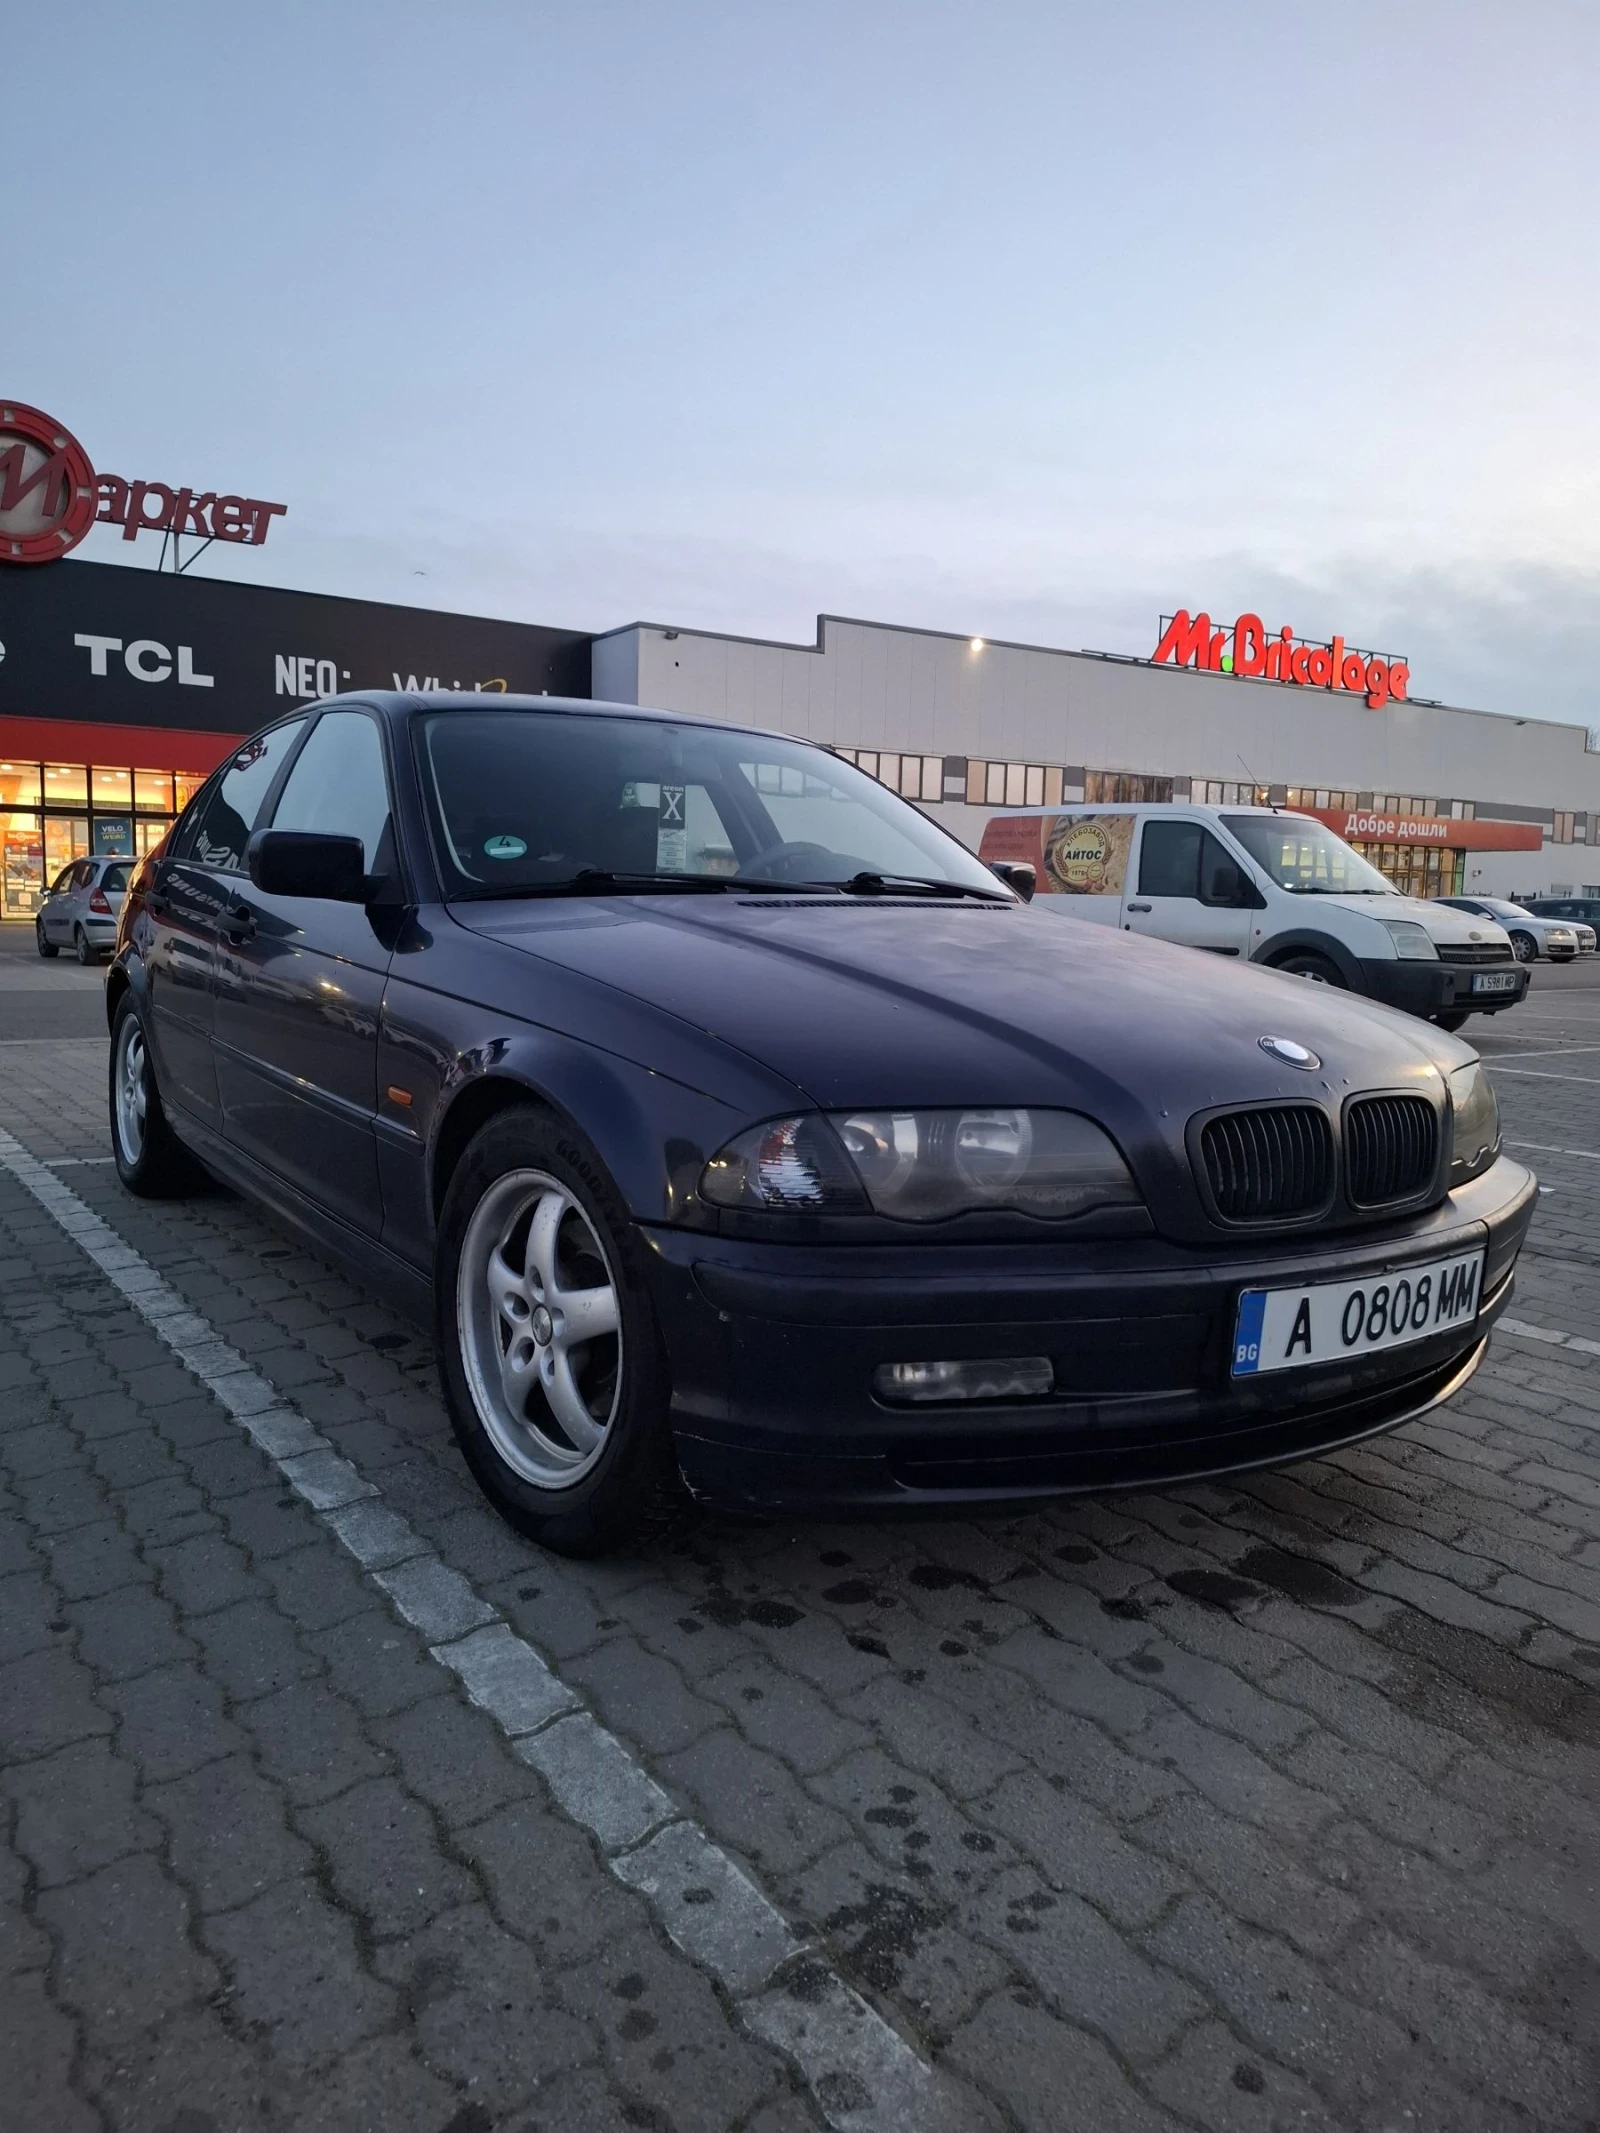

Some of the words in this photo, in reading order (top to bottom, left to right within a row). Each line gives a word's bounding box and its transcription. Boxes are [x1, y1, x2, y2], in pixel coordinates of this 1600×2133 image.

[74, 633, 214, 687] TCL
[662, 792, 683, 820] X
[1345, 813, 1395, 836] Добре
[1398, 821, 1447, 838] дошли
[1065, 848, 1102, 860] АЙТОС
[1285, 1297, 1312, 1358] A
[1236, 1344, 1257, 1362] BG
